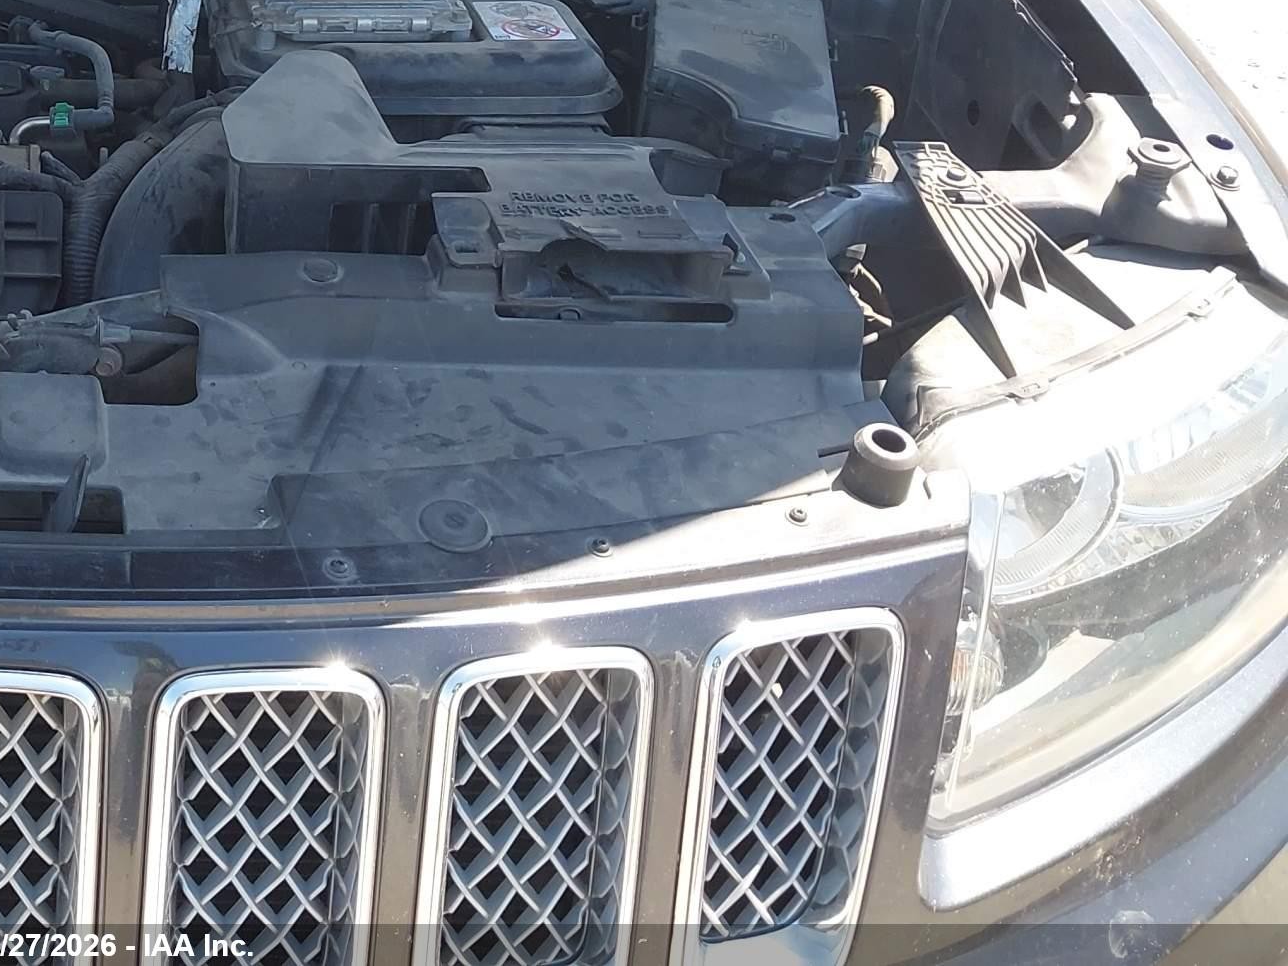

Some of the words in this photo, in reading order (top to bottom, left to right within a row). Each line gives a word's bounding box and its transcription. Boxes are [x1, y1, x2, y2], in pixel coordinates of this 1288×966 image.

[510, 191, 593, 204] REMOVE
[597, 192, 640, 204] FOR
[592, 204, 670, 218] ACCESS
